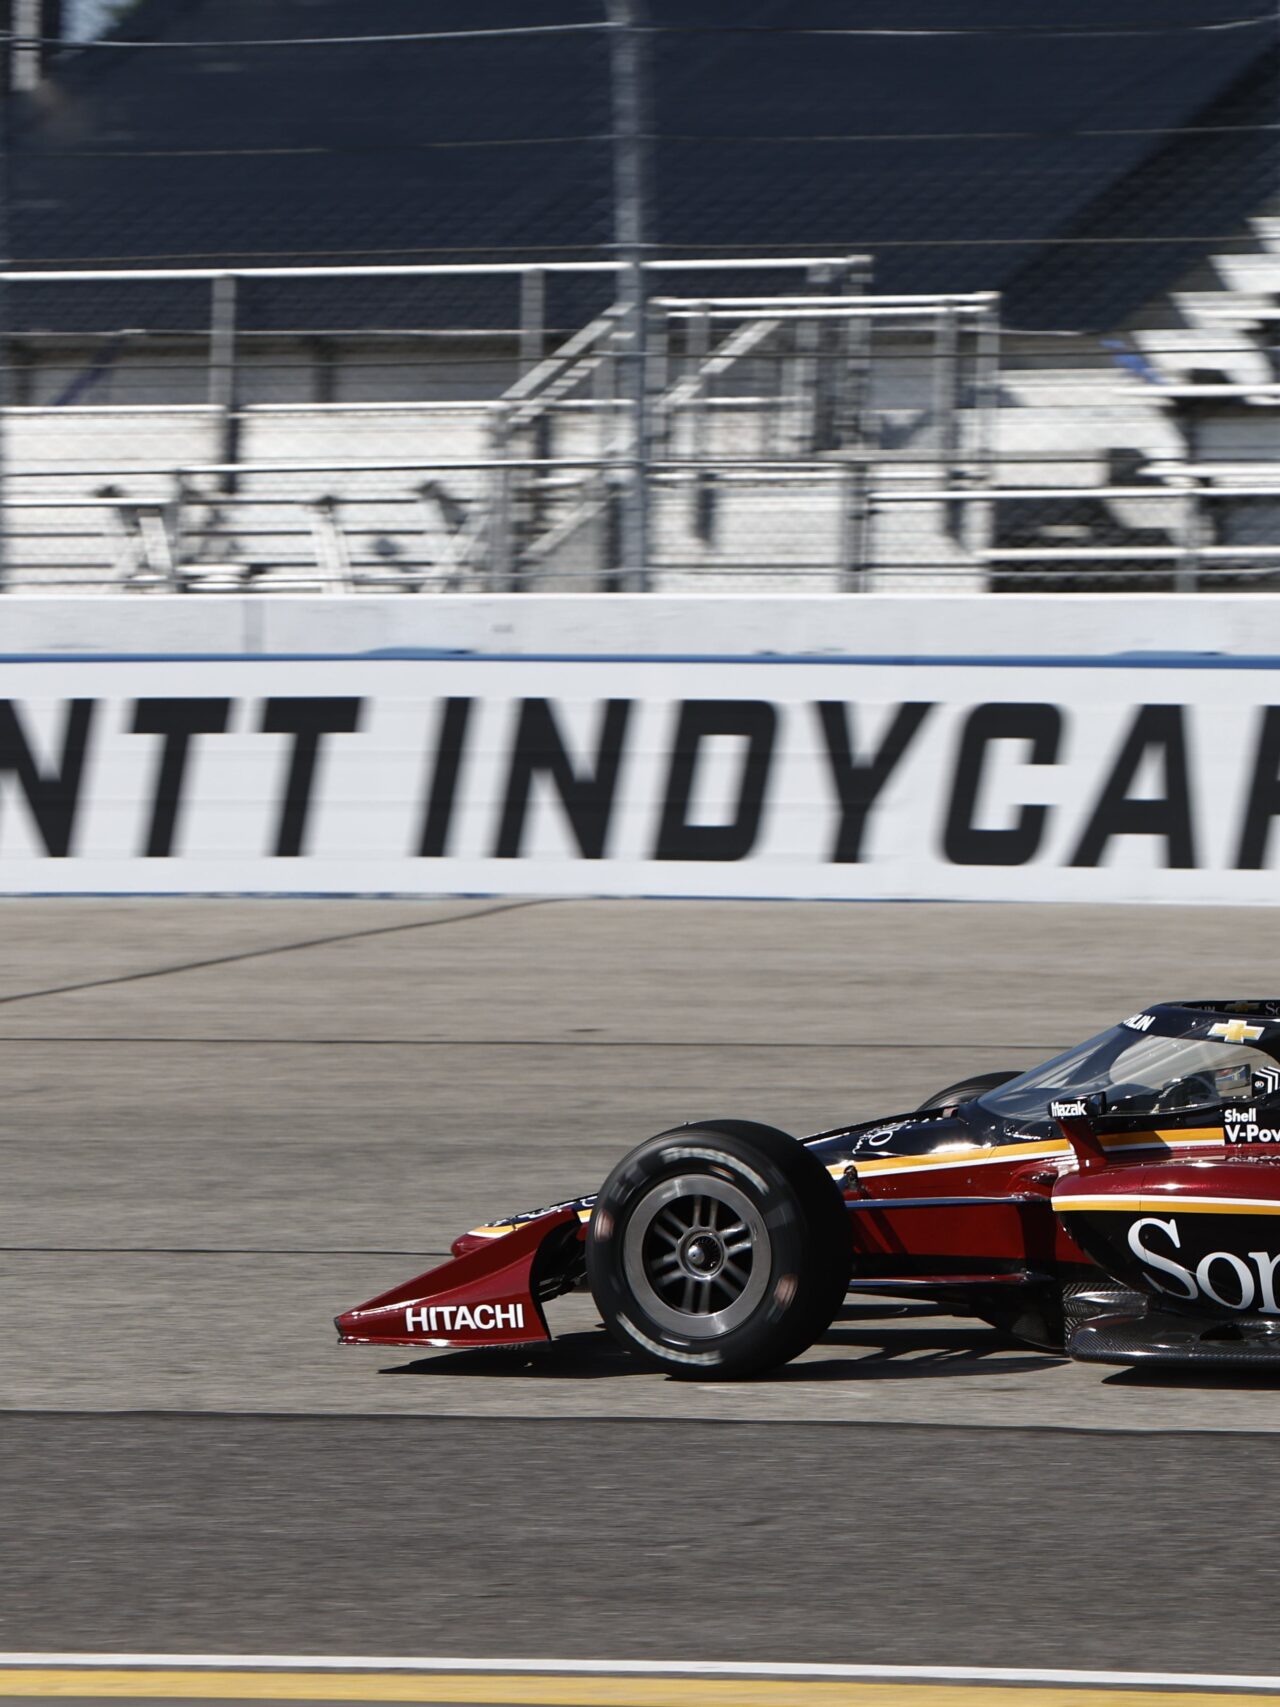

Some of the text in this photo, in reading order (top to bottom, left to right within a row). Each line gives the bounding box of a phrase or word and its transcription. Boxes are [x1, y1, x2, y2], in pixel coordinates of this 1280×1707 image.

[0, 697, 368, 858] NTT
[1051, 1100, 1087, 1117] Mazak
[1224, 1108, 1256, 1122] Shell
[405, 1303, 524, 1332] HITACHI
